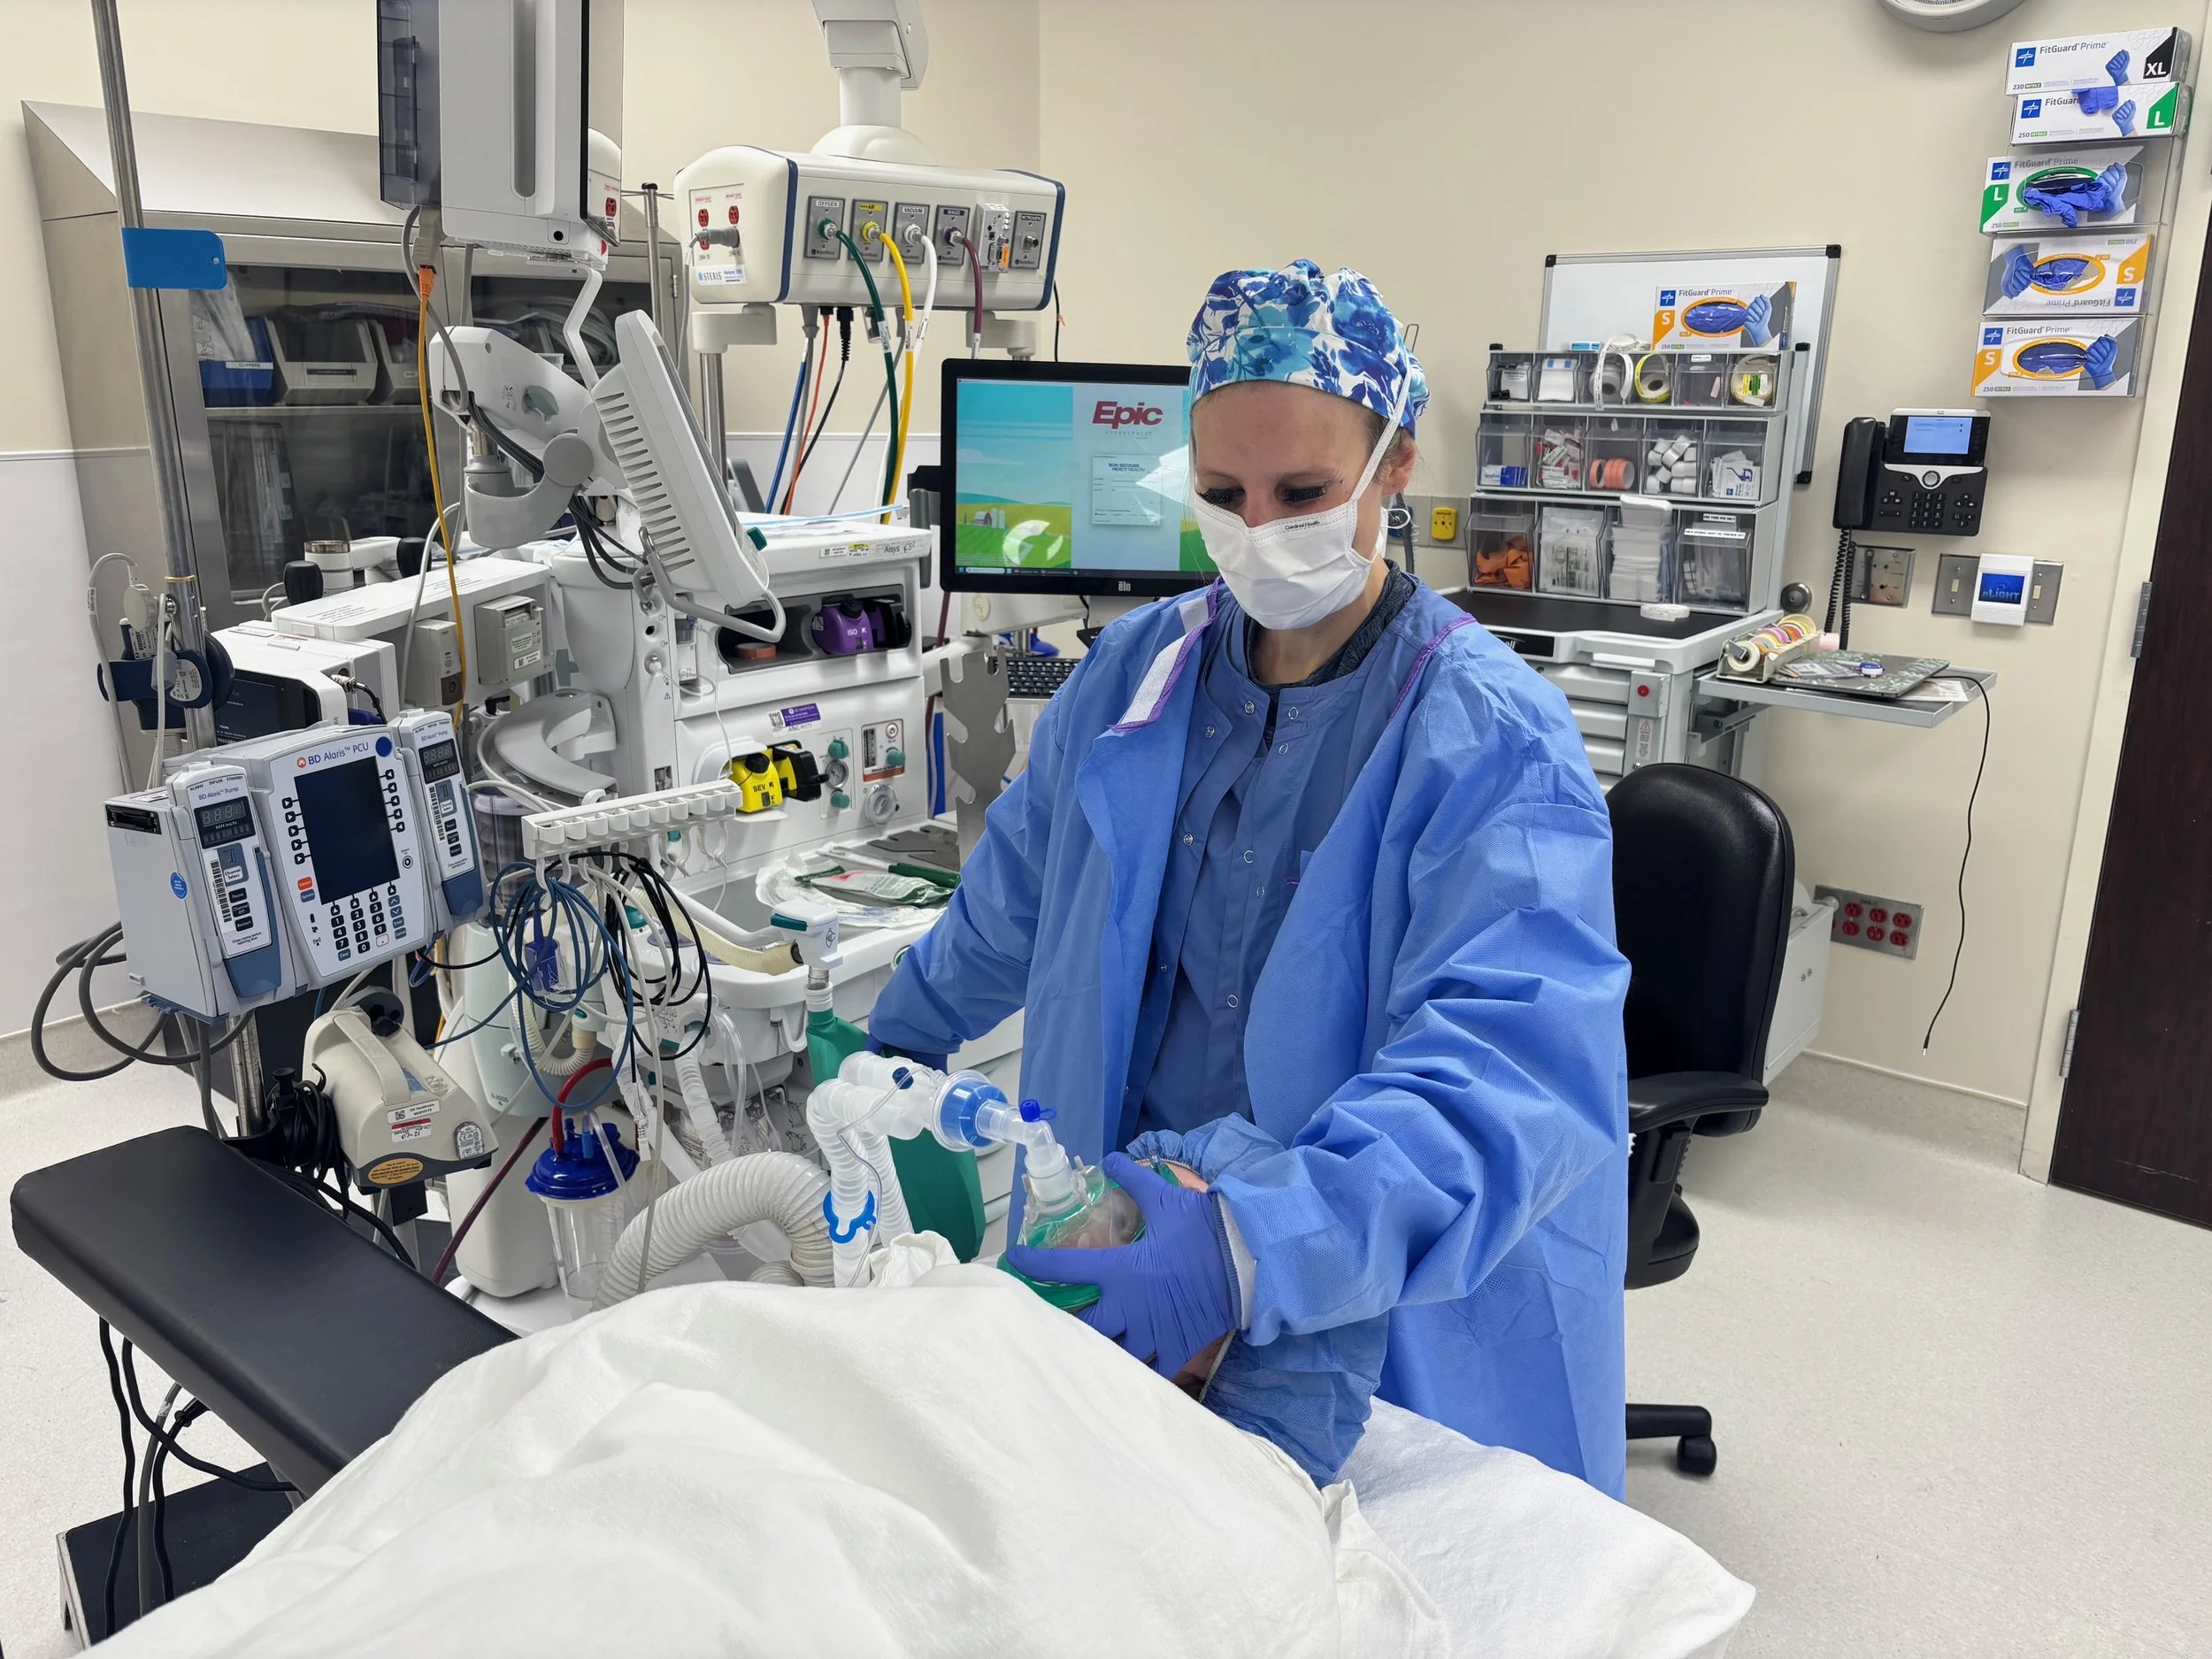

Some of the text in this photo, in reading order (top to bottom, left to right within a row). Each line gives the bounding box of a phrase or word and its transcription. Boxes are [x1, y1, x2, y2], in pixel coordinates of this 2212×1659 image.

[2039, 42, 2107, 54] FitGuard Prime
[2145, 62, 2167, 76] XL
[2154, 111, 2165, 127] L
[2015, 159, 2050, 168] FitGuard
[1993, 187, 2003, 201] L
[703, 272, 722, 280] STERIS
[2124, 267, 2136, 281] S
[1661, 311, 1671, 325] S
[1985, 351, 1996, 365] S
[1093, 401, 1164, 429] Epic
[308, 754, 321, 765] BD
[353, 741, 369, 753] PCU
